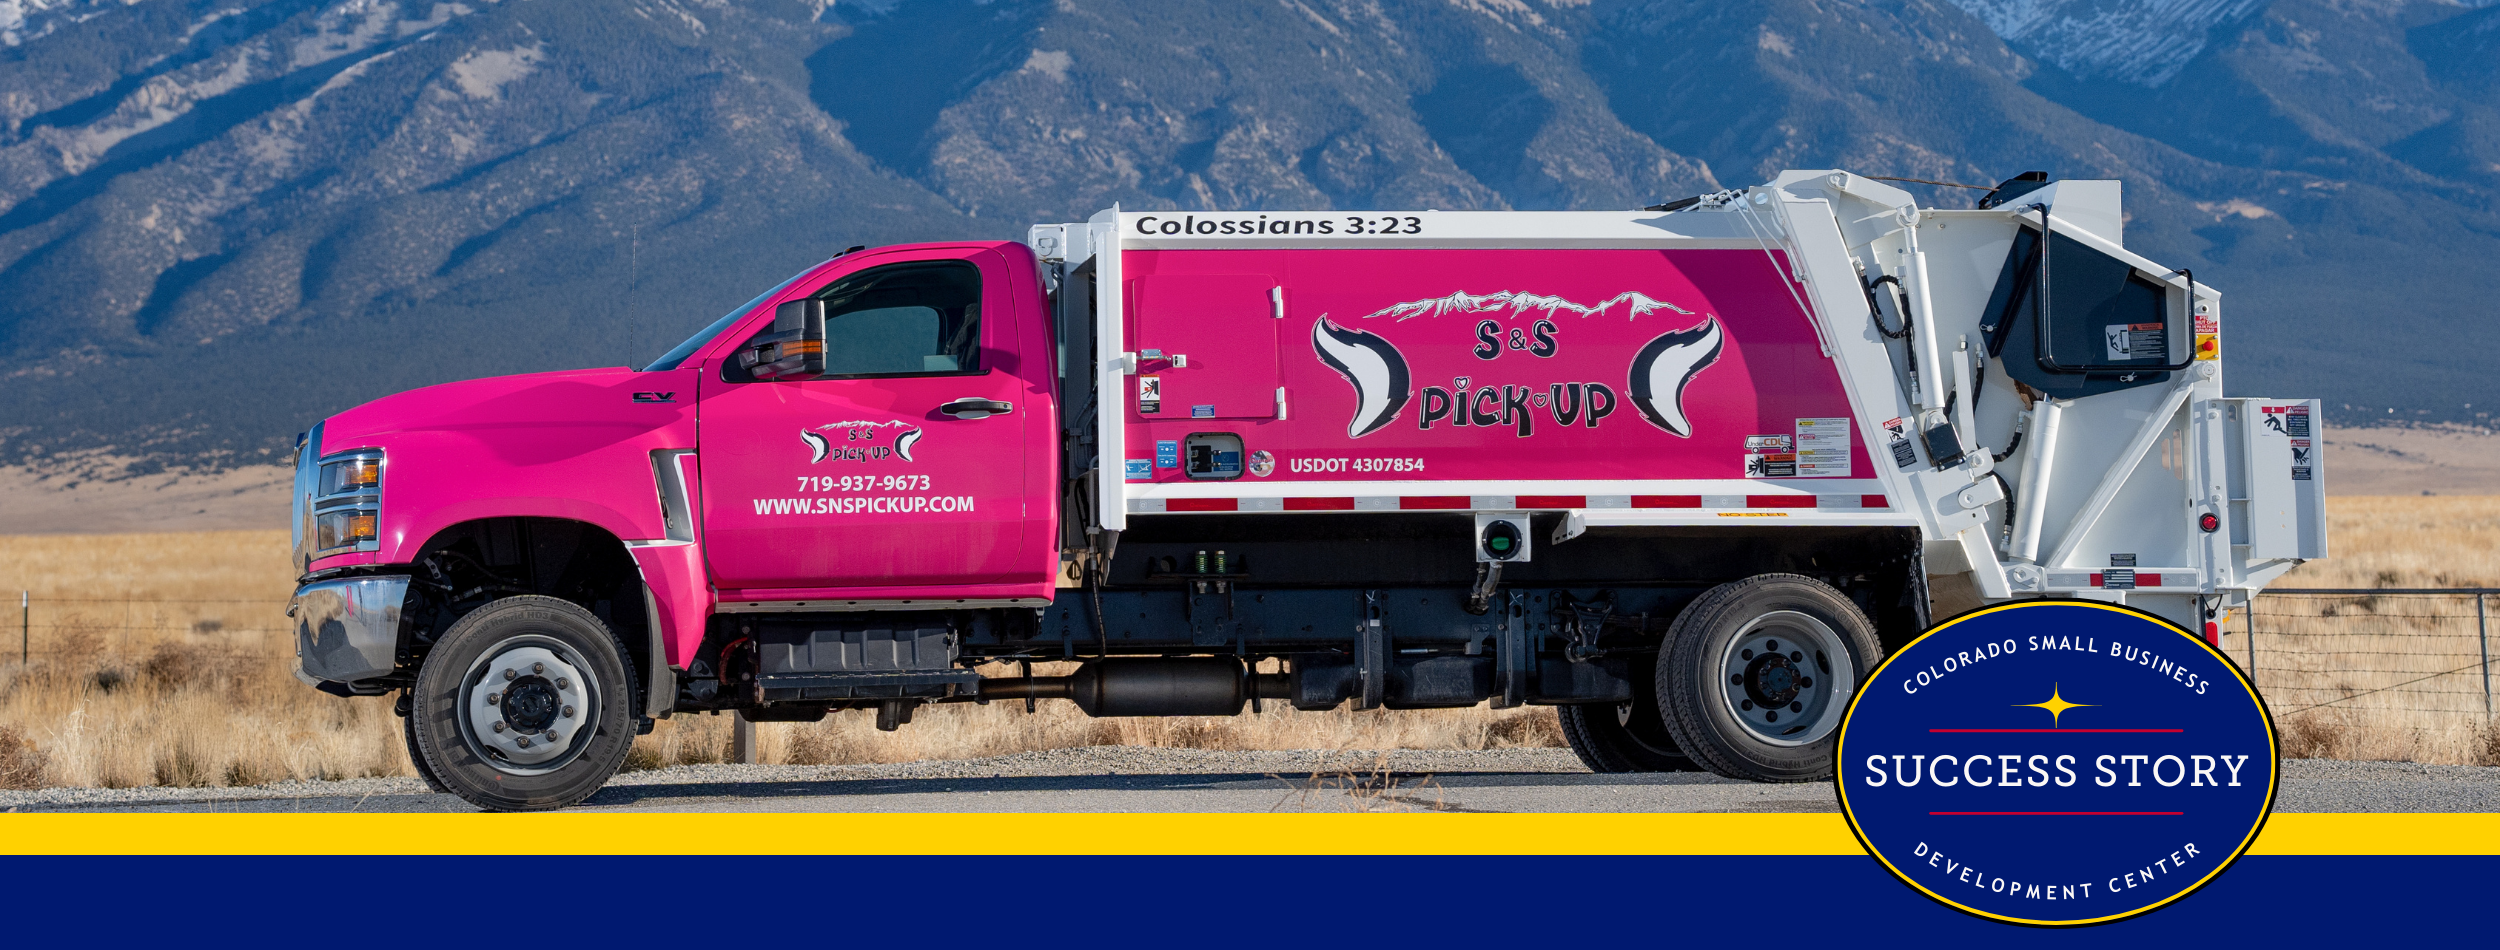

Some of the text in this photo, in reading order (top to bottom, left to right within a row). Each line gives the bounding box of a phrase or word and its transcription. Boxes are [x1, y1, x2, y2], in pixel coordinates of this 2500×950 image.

[1136, 214, 1422, 235] Colossians 3:23
[1290, 458, 1347, 473] USDOT
[1352, 458, 1425, 472] 4307854
[797, 474, 931, 492] 719-937-9673
[753, 496, 975, 515] WWW.SNSPICKUP.COM
